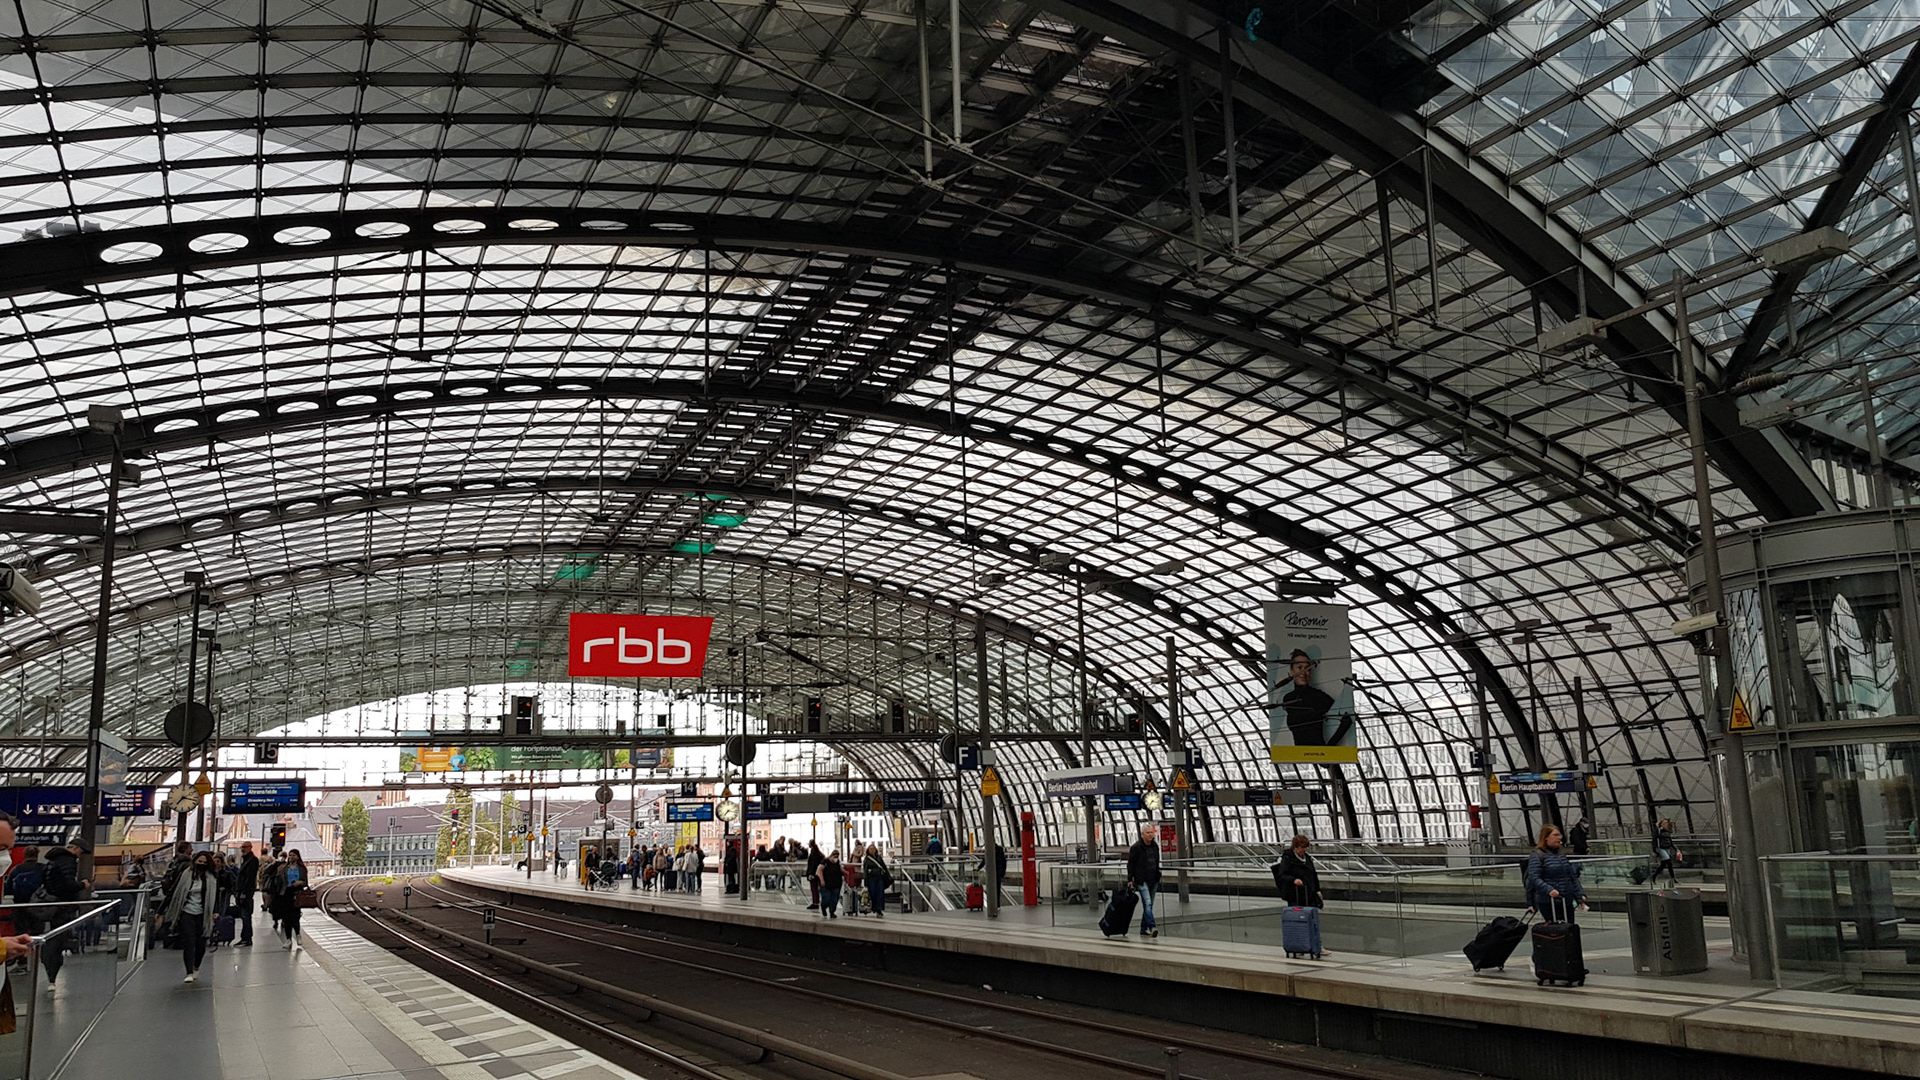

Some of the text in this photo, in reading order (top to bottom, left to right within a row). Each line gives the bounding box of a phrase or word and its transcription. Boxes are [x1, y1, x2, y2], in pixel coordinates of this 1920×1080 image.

[1284, 611, 1329, 627] Personio
[583, 627, 691, 664] rbb
[258, 742, 278, 759] 15
[958, 747, 969, 765] F
[1191, 749, 1200, 765] F
[1472, 752, 1479, 764] F
[1595, 762, 1602, 773] F
[683, 782, 694, 793] 14
[1048, 779, 1099, 793] Berlin Hauptbahnhof
[1518, 782, 1557, 792] Hauptbahnhof
[765, 796, 779, 809] 14
[928, 792, 941, 805] 13
[1201, 792, 1212, 802] 12
[485, 910, 494, 922] H
[1660, 917, 1672, 960] Abfall
